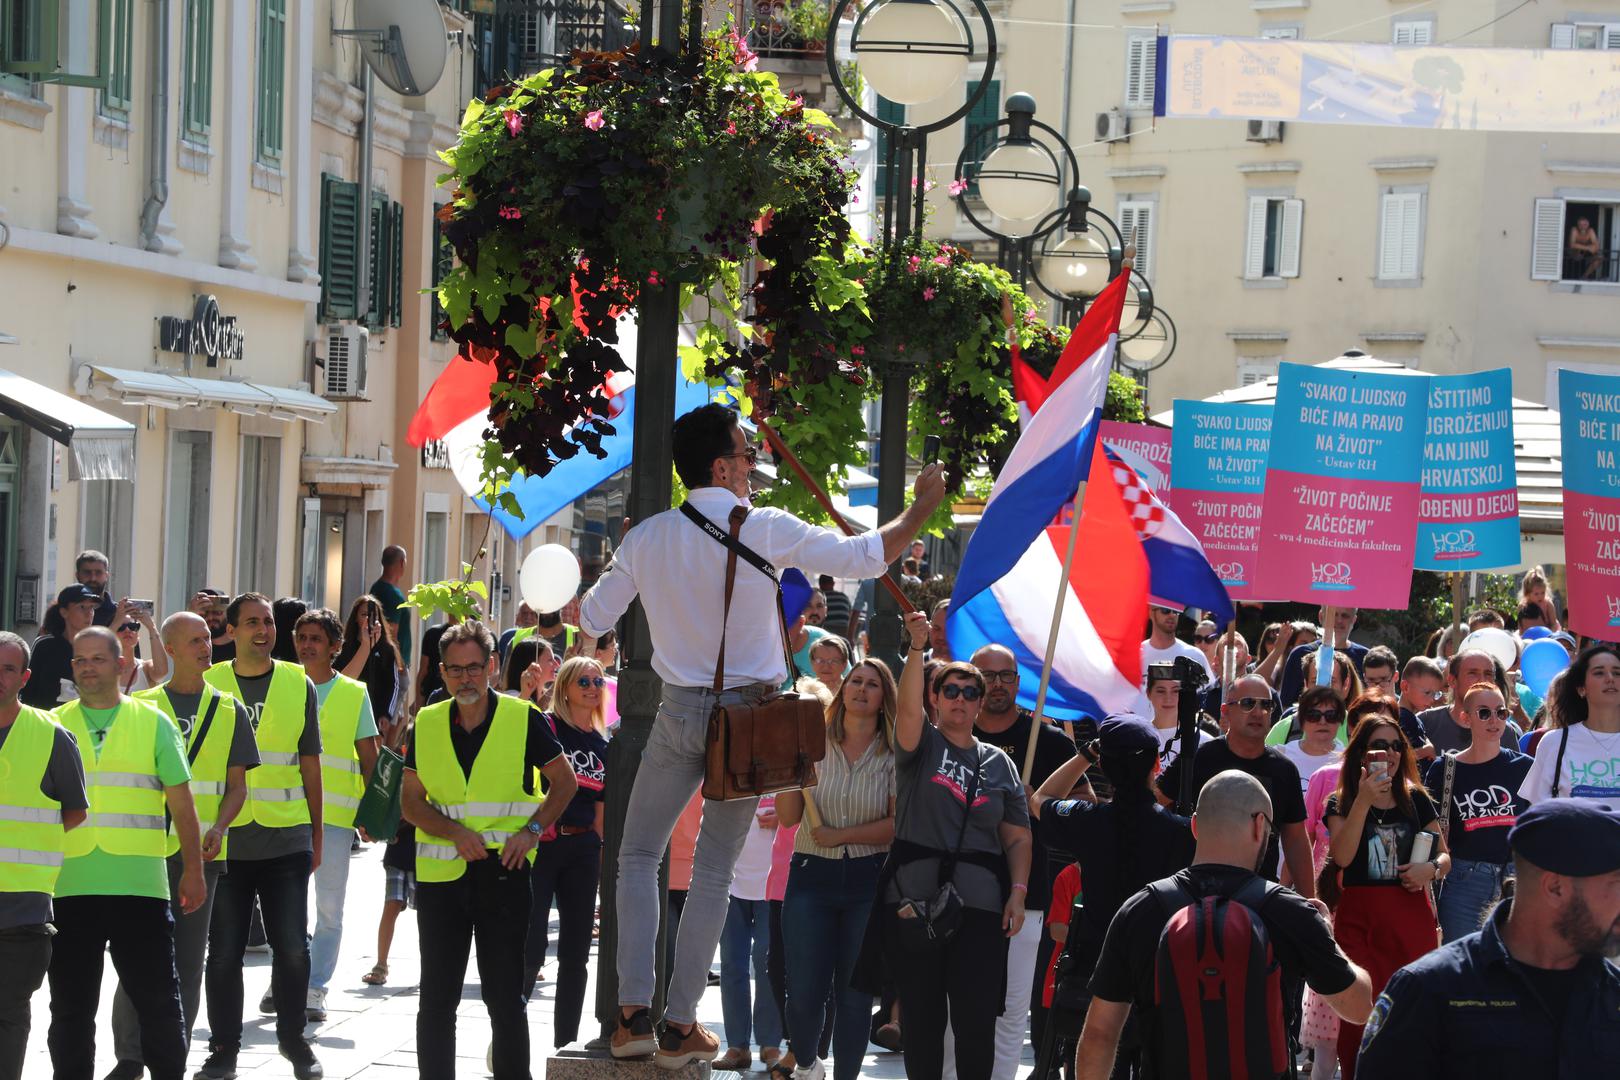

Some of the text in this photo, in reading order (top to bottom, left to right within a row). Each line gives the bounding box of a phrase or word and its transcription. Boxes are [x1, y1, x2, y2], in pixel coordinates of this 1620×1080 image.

[1351, 387, 1407, 407] LJUDSKO
[1300, 406, 1404, 432] BIĆE IMA PRAVO
[1580, 418, 1607, 440] BIĆE
[1193, 433, 1218, 450] BIĆE
[1221, 437, 1242, 451] IMA
[1315, 434, 1334, 451] NA
[1424, 439, 1489, 461] MANJINU
[1208, 456, 1223, 471] NA
[1325, 456, 1356, 469] Ustav
[1358, 459, 1377, 471] RH
[1597, 450, 1615, 469] NA
[1216, 474, 1243, 485] Ustav
[1244, 475, 1261, 486] RH
[1421, 464, 1503, 487] HRVATSKOJ
[1340, 491, 1393, 512] POČINJE
[1477, 493, 1515, 517] DJECU
[704, 522, 726, 540] SONY
[1431, 529, 1475, 546] HOD
[1203, 542, 1250, 551] medicinska
[1279, 533, 1295, 542] sva
[1296, 533, 1302, 543] 4
[1304, 536, 1360, 550] medicinska
[1361, 539, 1402, 552] fakulteta
[1311, 561, 1351, 578] HOD
[1591, 563, 1596, 573] 4
[1453, 784, 1512, 814] HOD
[1459, 804, 1517, 822] ZA ŽIVOT
